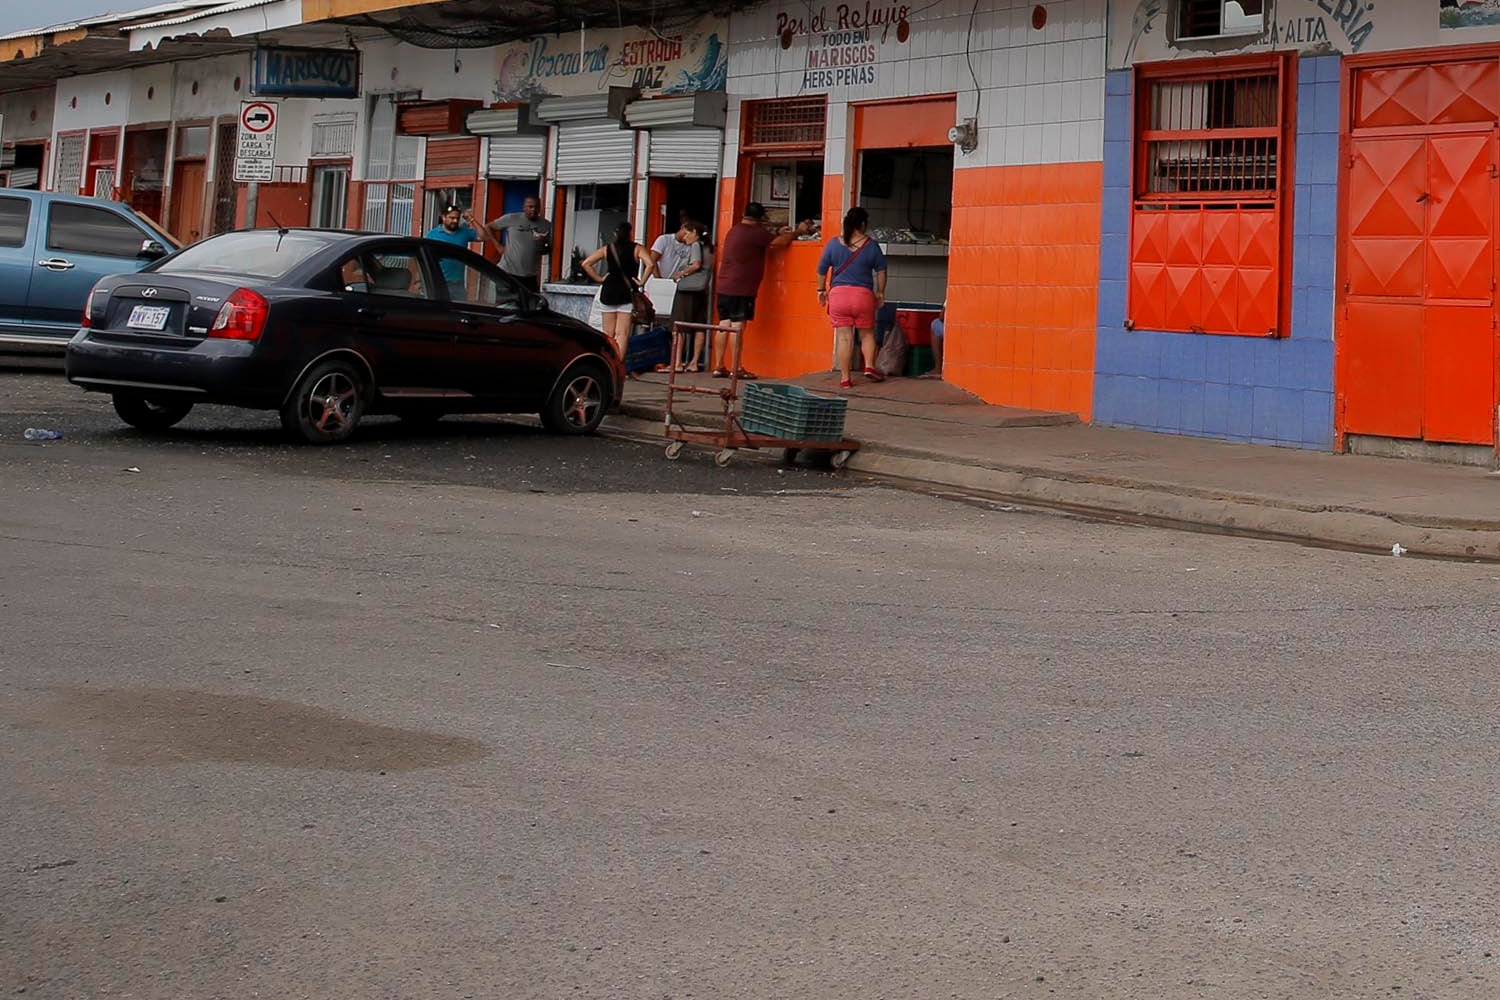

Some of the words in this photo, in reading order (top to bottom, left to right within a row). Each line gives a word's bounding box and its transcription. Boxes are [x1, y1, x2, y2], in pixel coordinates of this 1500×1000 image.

[821, 31, 852, 47] TODO
[853, 29, 865, 44] EN
[624, 36, 683, 66] ESTRADA
[808, 44, 876, 69] MARISCOS
[266, 54, 355, 85] MARISCOS
[241, 133, 257, 141] ZONA
